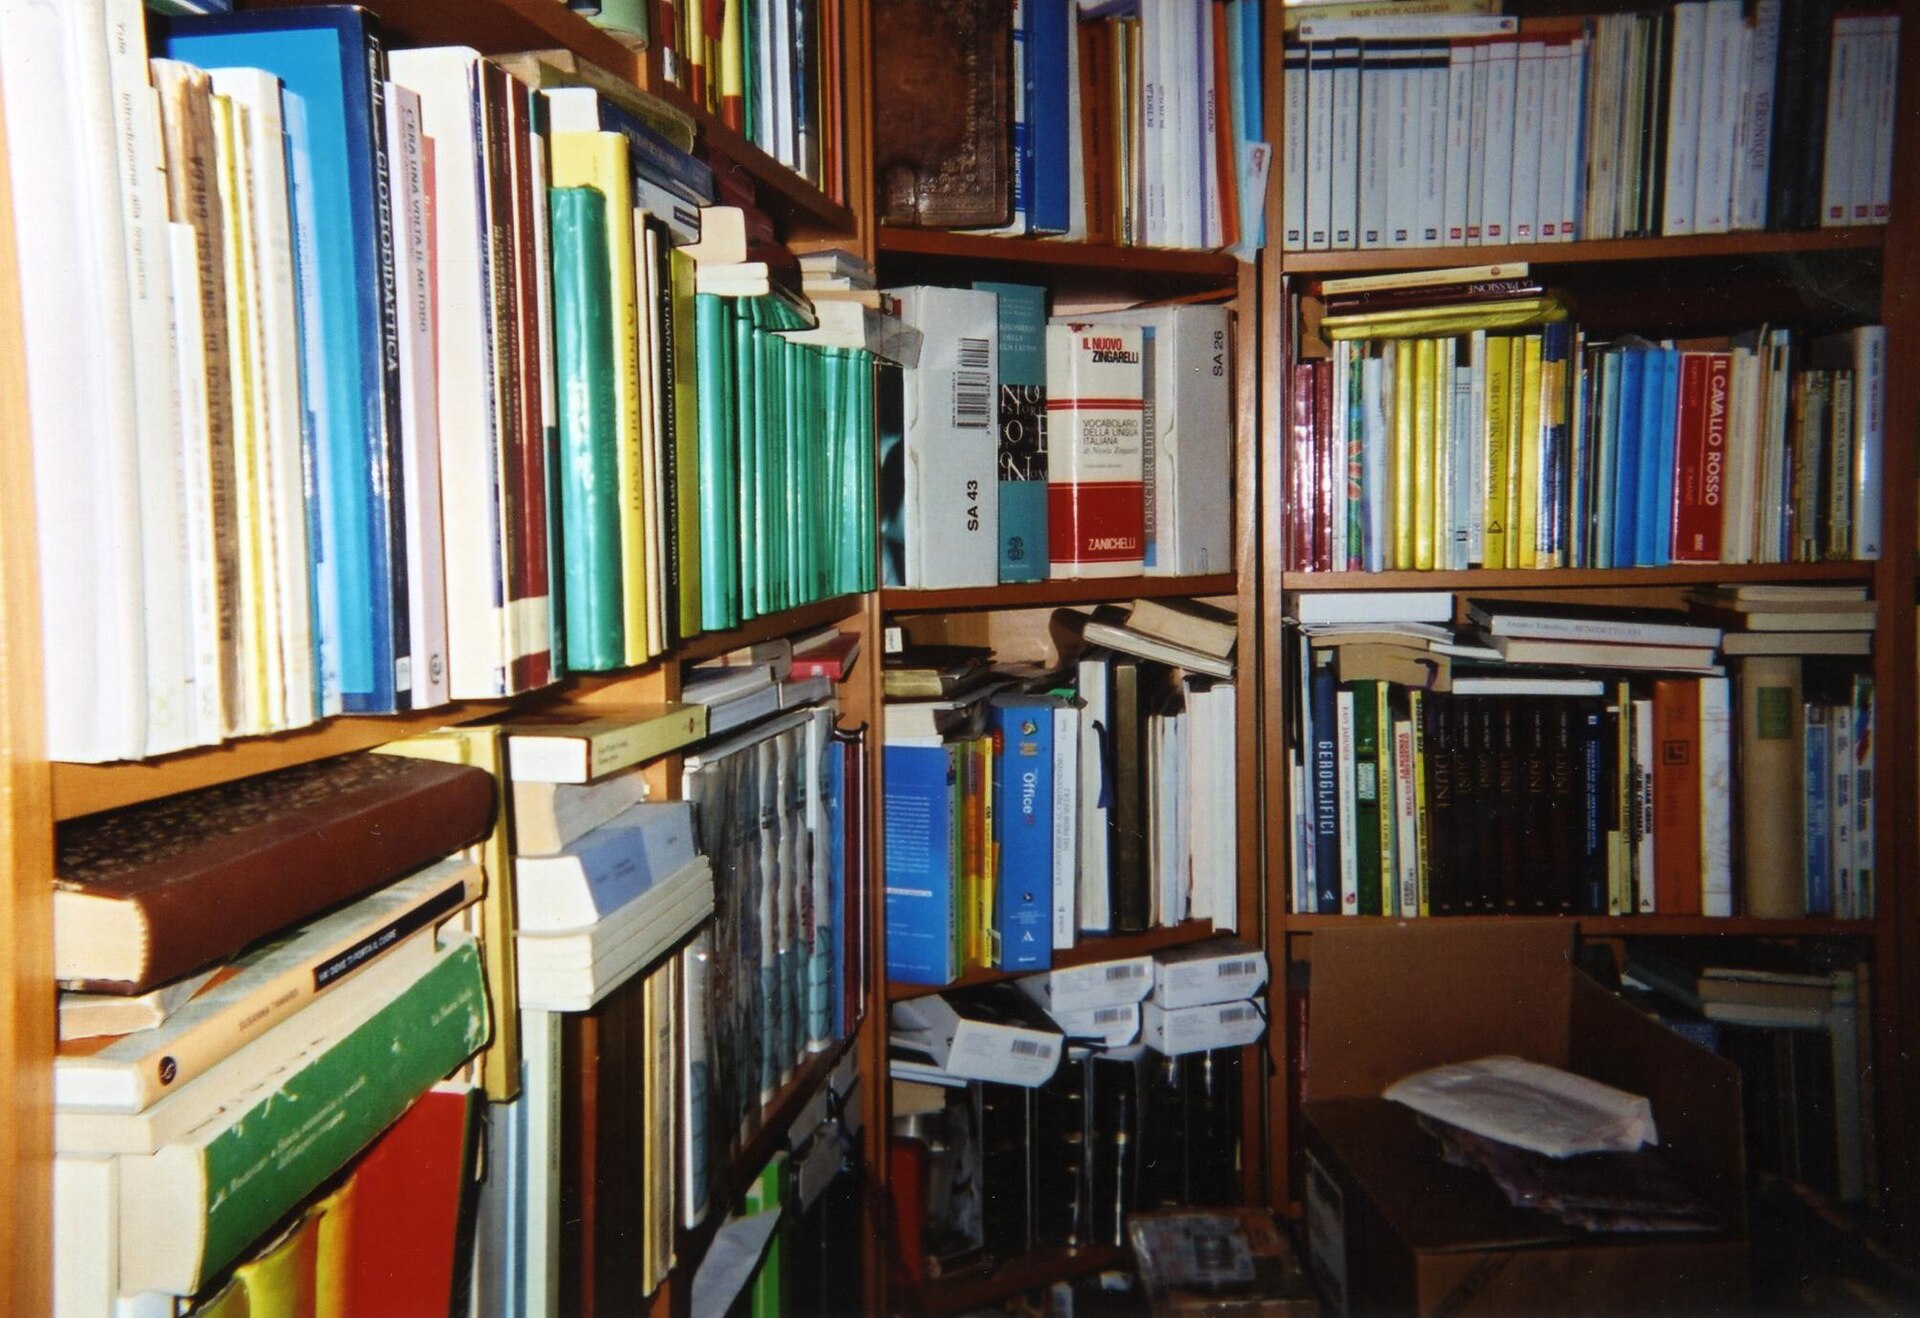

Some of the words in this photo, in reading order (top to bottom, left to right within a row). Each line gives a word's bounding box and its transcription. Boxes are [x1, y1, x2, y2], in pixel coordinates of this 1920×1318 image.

[367, 34, 383, 106] Freddi
[122, 92, 142, 186] Introduzione
[1751, 91, 1771, 172] VÉRONIQUE
[188, 155, 209, 219] GRECA
[408, 159, 420, 197] UNA
[131, 193, 144, 219] alla
[410, 199, 423, 249] VOLTA
[196, 231, 217, 319] SINTASSI
[376, 150, 400, 372] GLOTTODIDATTICA
[414, 270, 429, 333] METODO
[1467, 281, 1520, 295] PASSIONE
[627, 302, 638, 327] LA
[204, 331, 220, 352] DI
[664, 305, 673, 365] GRANDI
[1082, 337, 1091, 350] IL
[1092, 337, 1123, 351] NUOVO
[1213, 330, 1224, 350] 26
[629, 334, 640, 402] PORTA
[1091, 350, 1140, 364] ZINGARELLI
[1213, 354, 1224, 377] SA
[1713, 359, 1727, 373] IL
[666, 368, 675, 438] BATTAGLIE
[1490, 371, 1502, 405] CHIESA
[1144, 399, 1155, 459] EDITORE
[1489, 407, 1500, 439] NELLA
[1708, 374, 1726, 447] CAVALLO
[1082, 437, 1119, 446] ITALIANA
[1083, 428, 1110, 437] DELLA
[1112, 428, 1139, 438] LINGUA
[1488, 440, 1499, 494] MOVIMENTI
[1705, 451, 1722, 507] ROSSO
[966, 479, 978, 501] 43
[1145, 463, 1156, 533] LOESCHER
[967, 505, 979, 532] SA
[671, 536, 679, 586] GRECIA
[1087, 537, 1136, 551] ZANICHELLI
[1573, 625, 1624, 637] BENEDETTO
[1626, 628, 1642, 637] XVI
[1342, 727, 1351, 762] JAPANESE
[1022, 772, 1036, 815] Office
[1318, 740, 1334, 835] GEROGLIFICI
